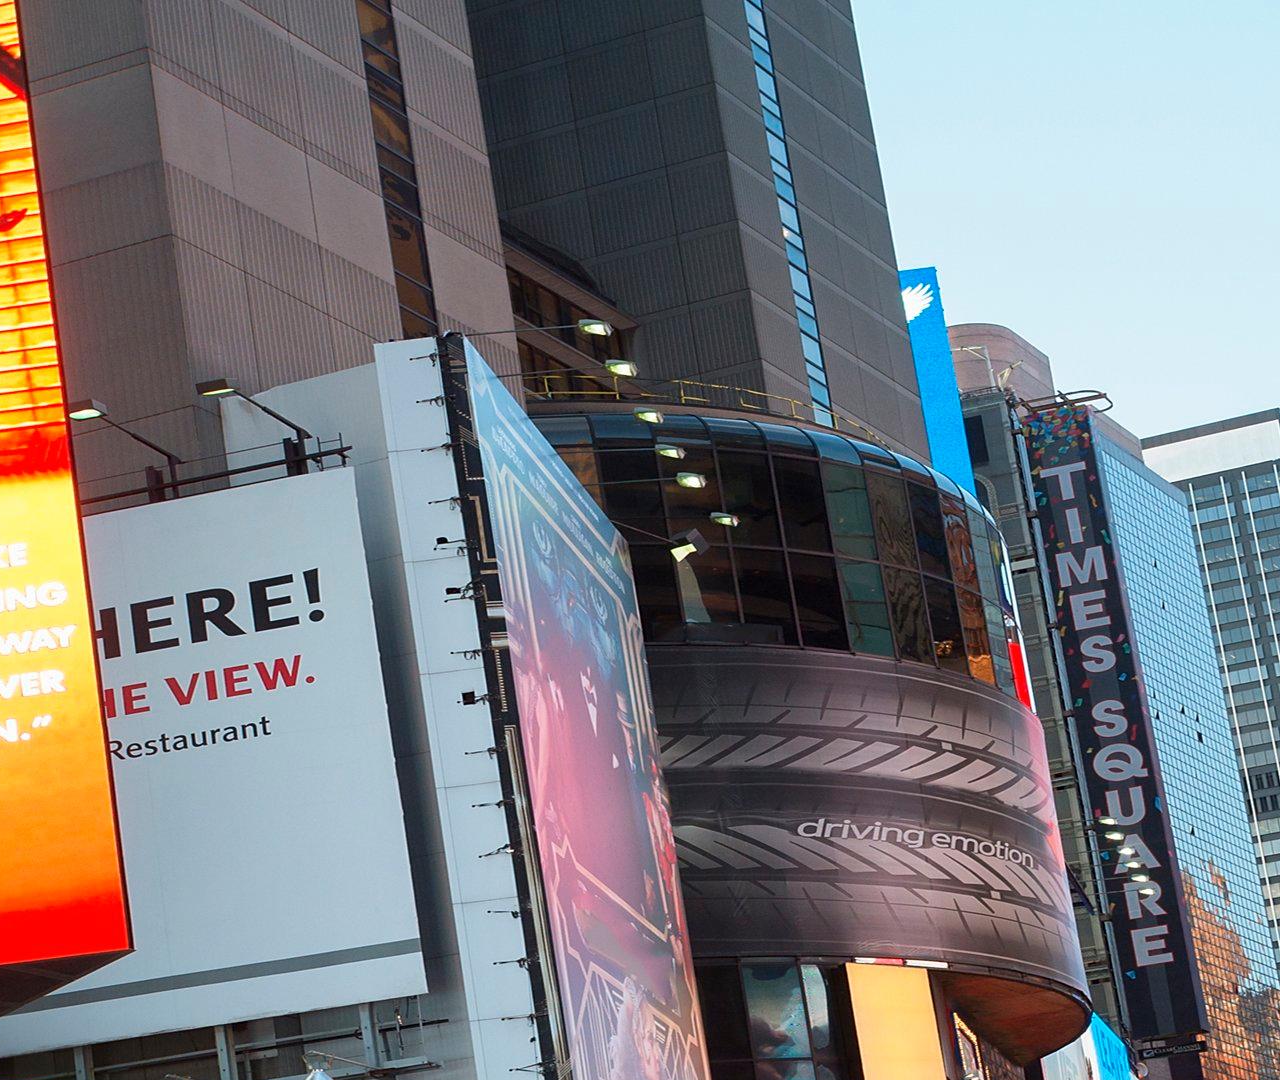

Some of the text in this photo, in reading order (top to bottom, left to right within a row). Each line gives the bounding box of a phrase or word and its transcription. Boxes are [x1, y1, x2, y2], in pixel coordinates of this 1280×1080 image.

[164, 654, 315, 706] VIEW.
[108, 716, 272, 761] Restaurant
[1038, 461, 1177, 969] TIMES SQUARE
[797, 818, 1035, 869] driving emotion
